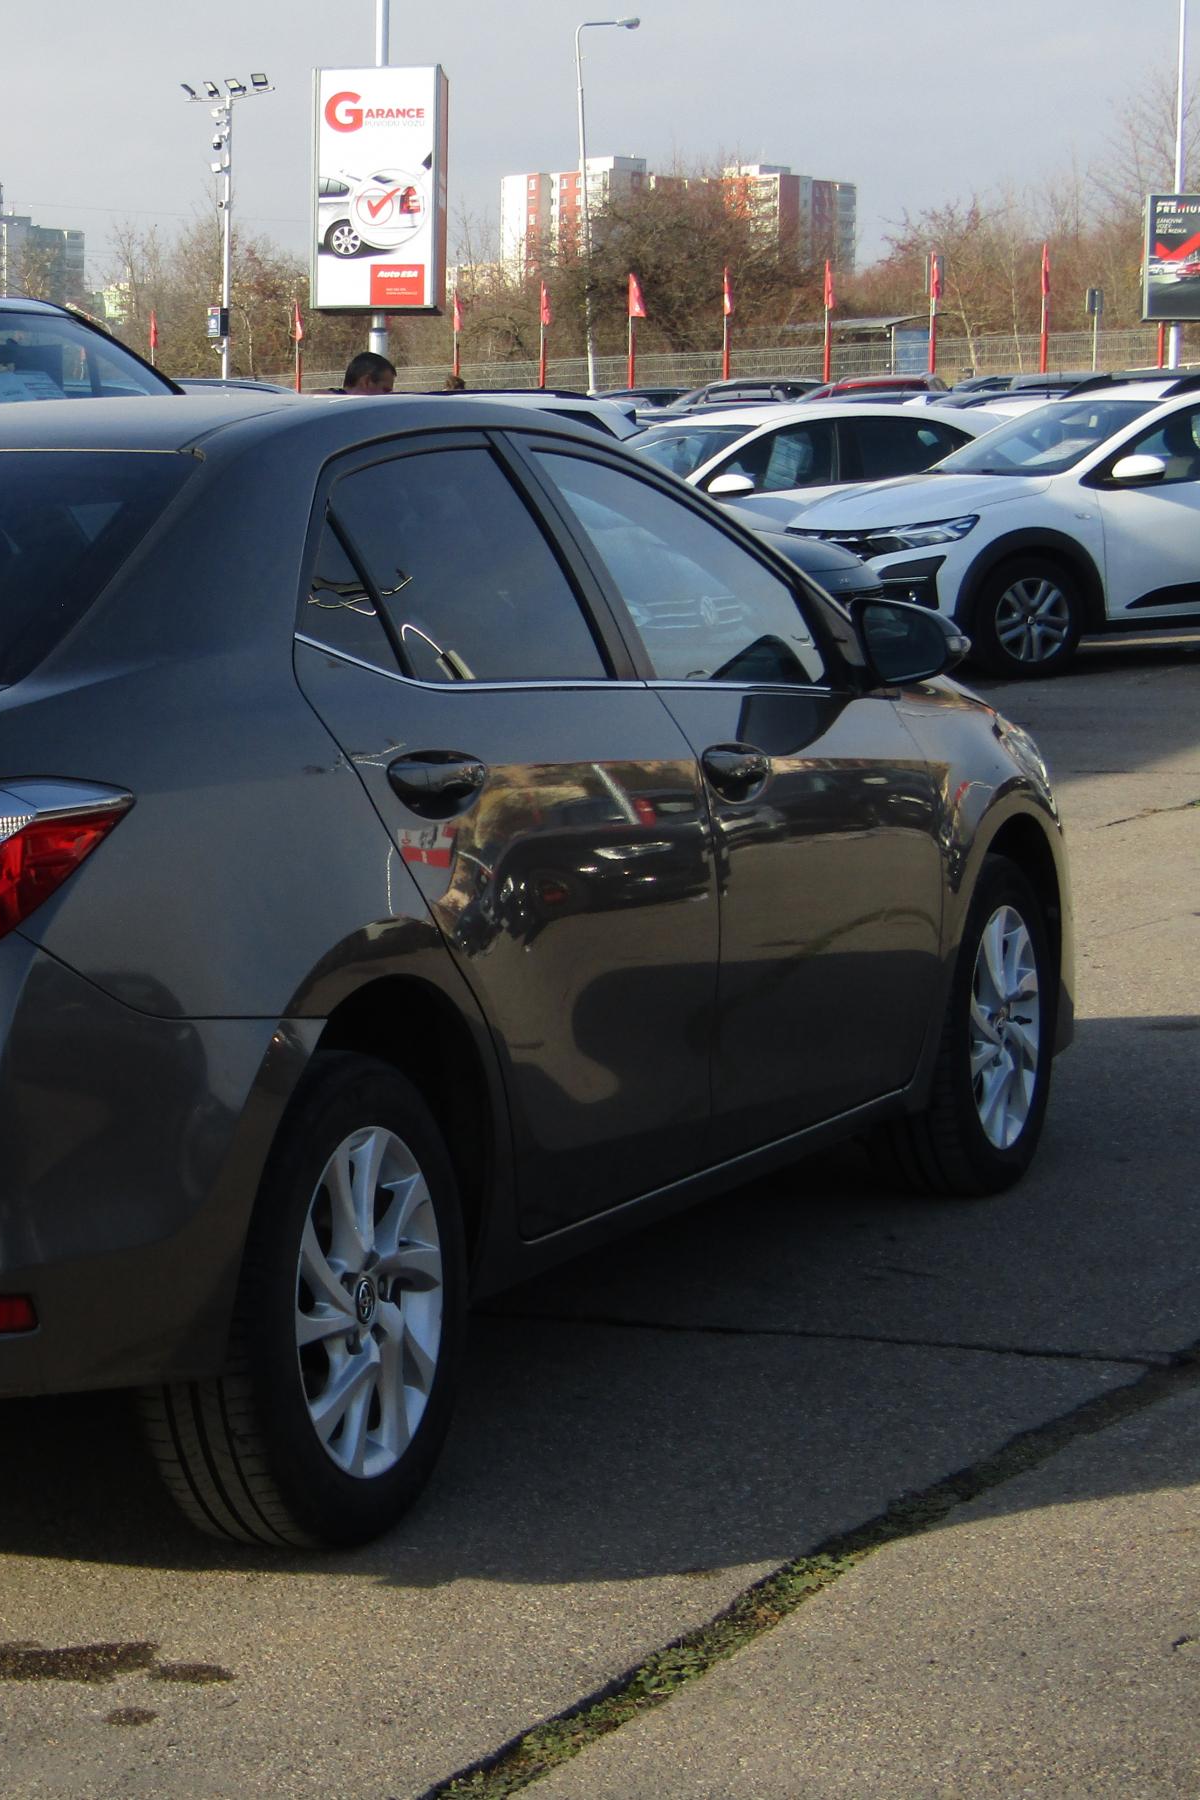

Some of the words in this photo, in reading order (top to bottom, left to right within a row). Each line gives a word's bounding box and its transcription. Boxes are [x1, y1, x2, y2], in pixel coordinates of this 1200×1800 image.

[324, 91, 425, 133] GARANCE
[1156, 205, 1200, 213] PREMIU
[377, 270, 400, 278] Auto
[400, 270, 418, 278] ESA
